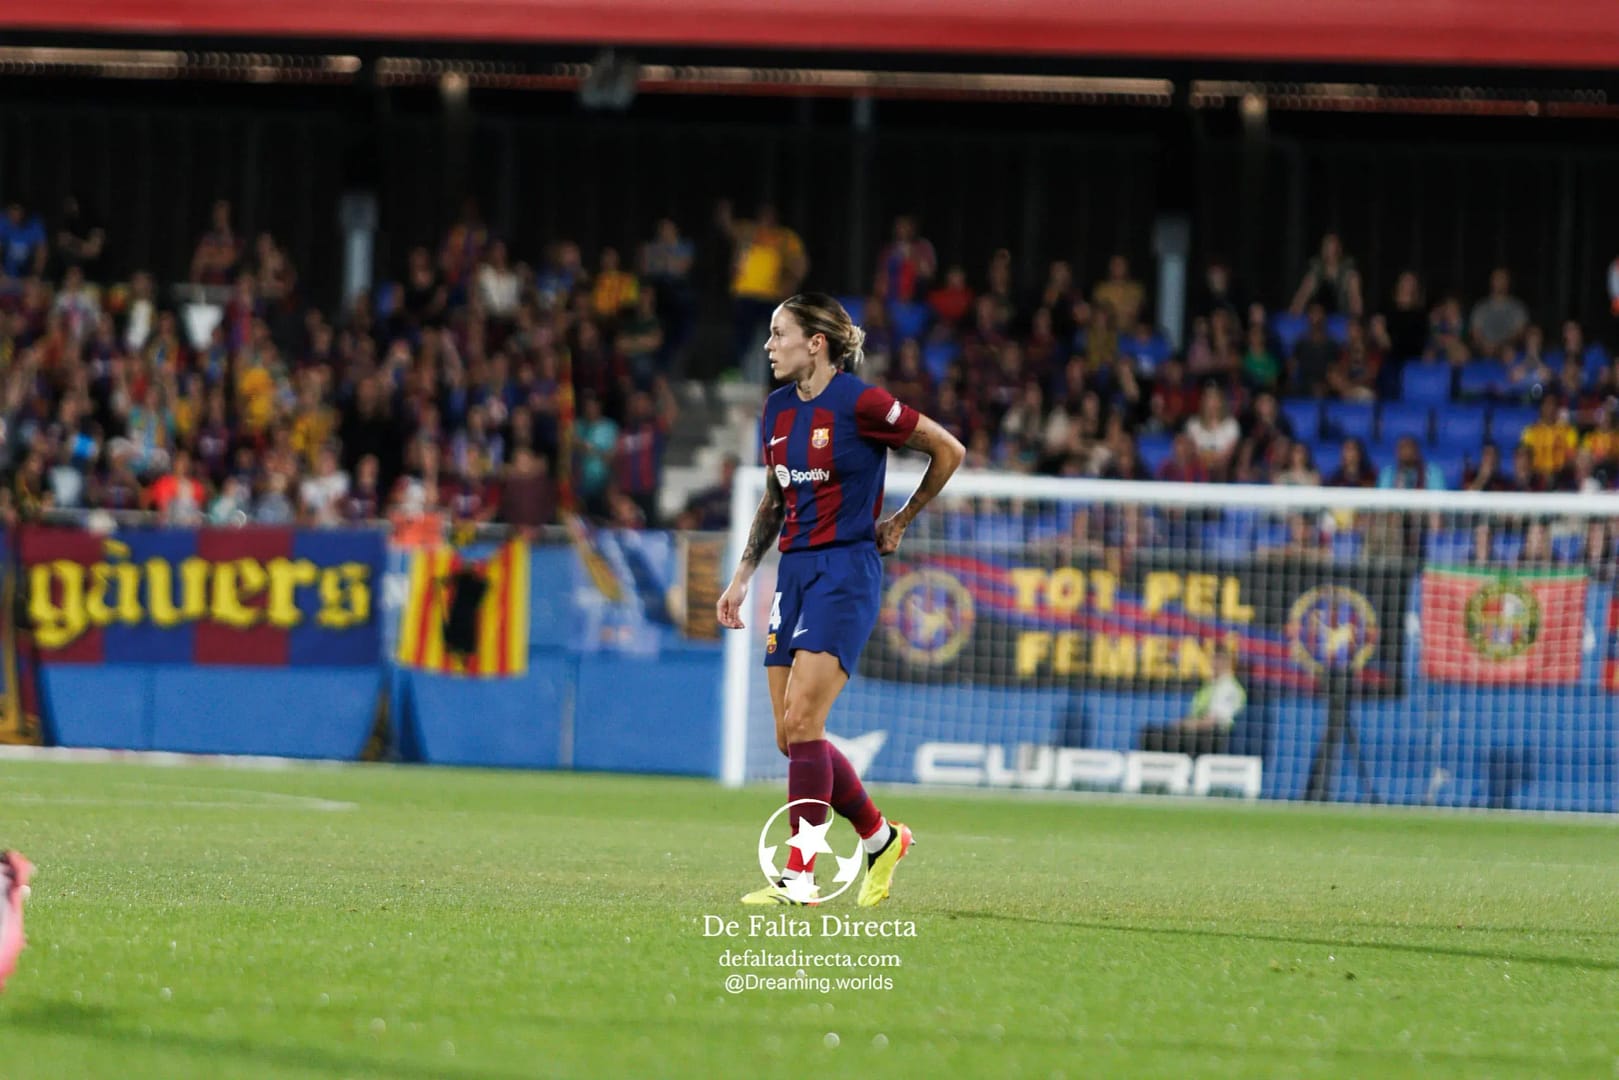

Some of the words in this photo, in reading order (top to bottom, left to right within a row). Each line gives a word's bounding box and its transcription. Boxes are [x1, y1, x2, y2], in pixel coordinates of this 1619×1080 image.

[791, 468, 830, 483] Spotify
[1012, 567, 1118, 614] TOT
[1142, 572, 1256, 622] PEL
[915, 742, 1263, 799] CUPRA
